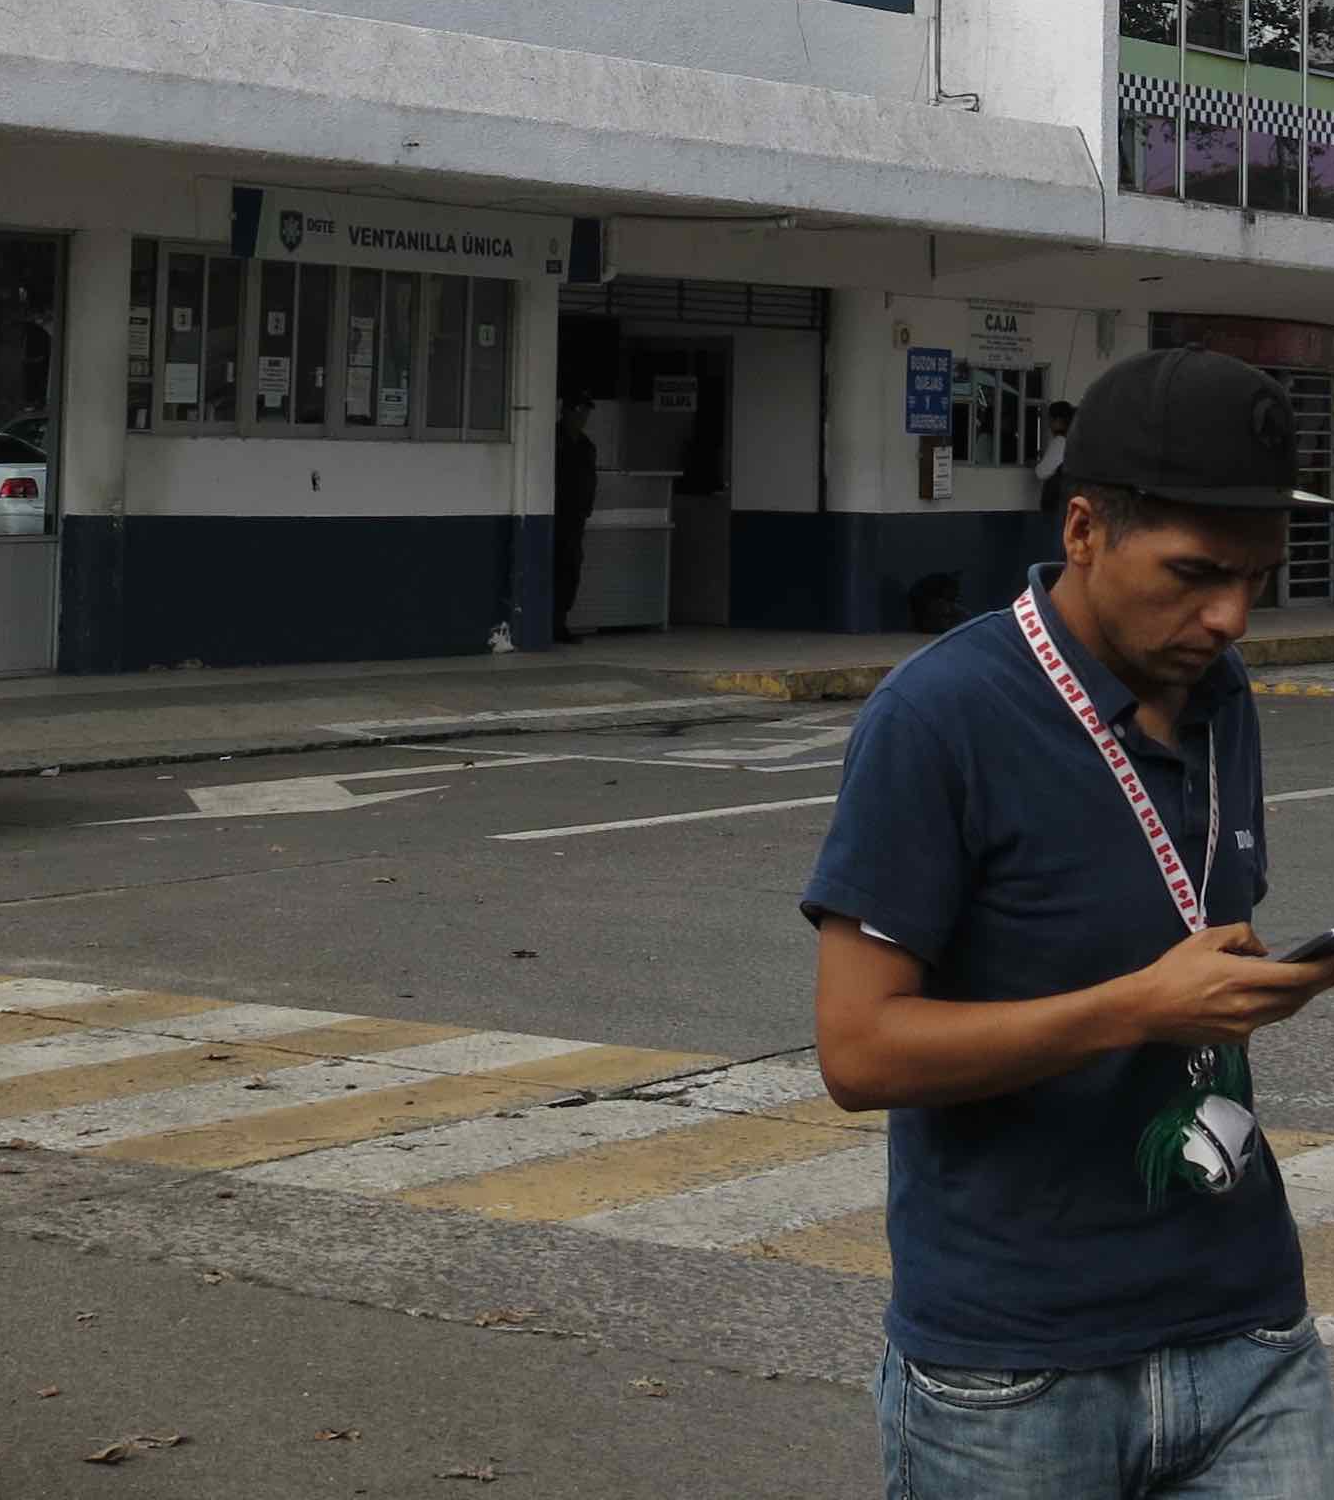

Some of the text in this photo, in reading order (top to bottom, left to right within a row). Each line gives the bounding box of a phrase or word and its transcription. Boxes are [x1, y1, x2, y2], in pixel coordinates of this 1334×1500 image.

[348, 225, 457, 255] VENTANILLA
[461, 231, 513, 258] ÚNICA
[985, 314, 1018, 333] CAJA
